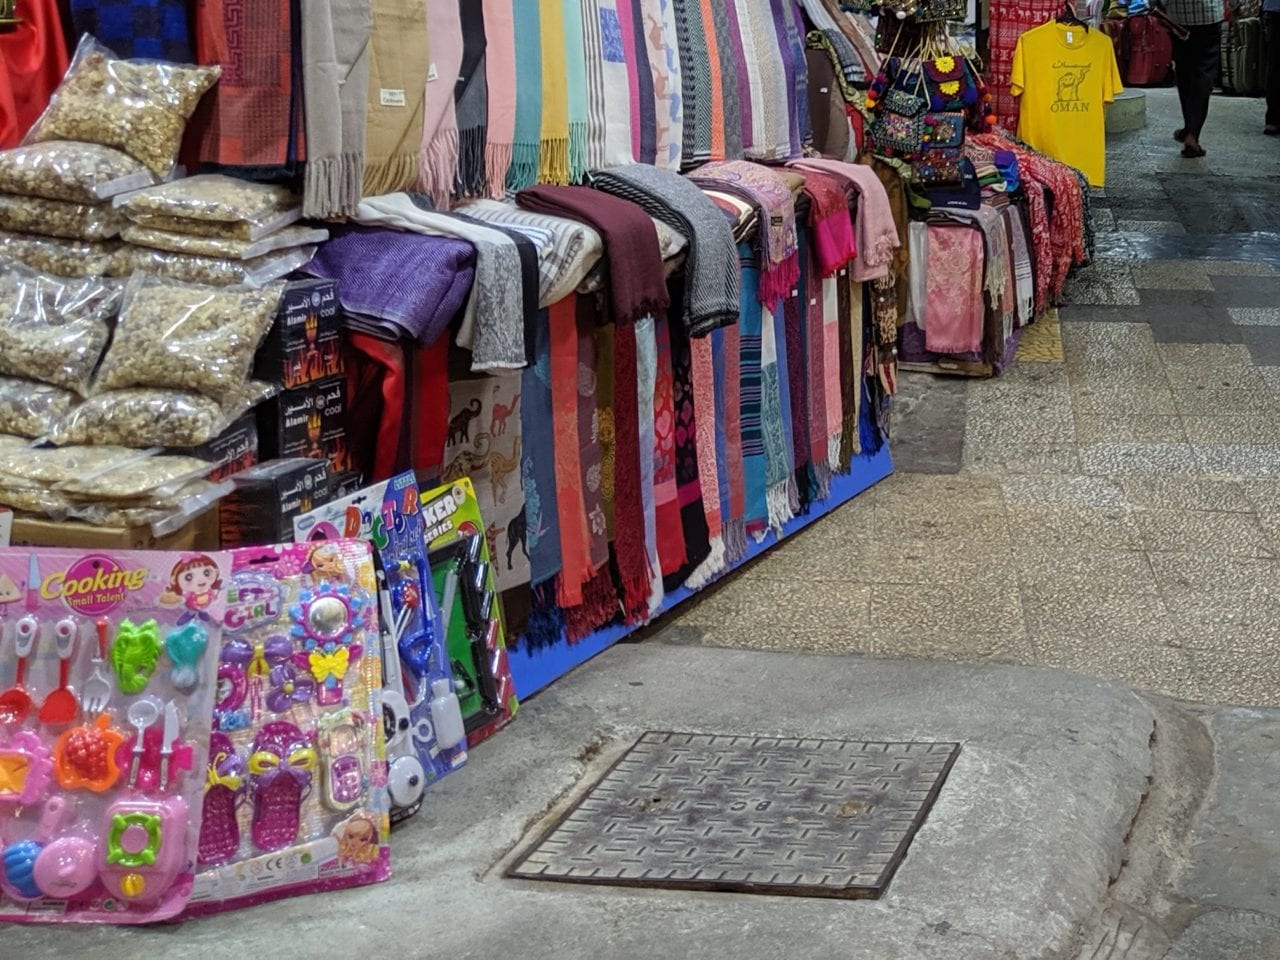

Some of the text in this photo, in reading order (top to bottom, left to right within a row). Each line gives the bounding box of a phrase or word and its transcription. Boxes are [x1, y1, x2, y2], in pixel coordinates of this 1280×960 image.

[1050, 101, 1090, 113] OMAN
[344, 486, 419, 550] DOCTOR
[40, 566, 147, 600] Cooking
[67, 591, 125, 607] Small Talent
[224, 602, 276, 629] GIRL
